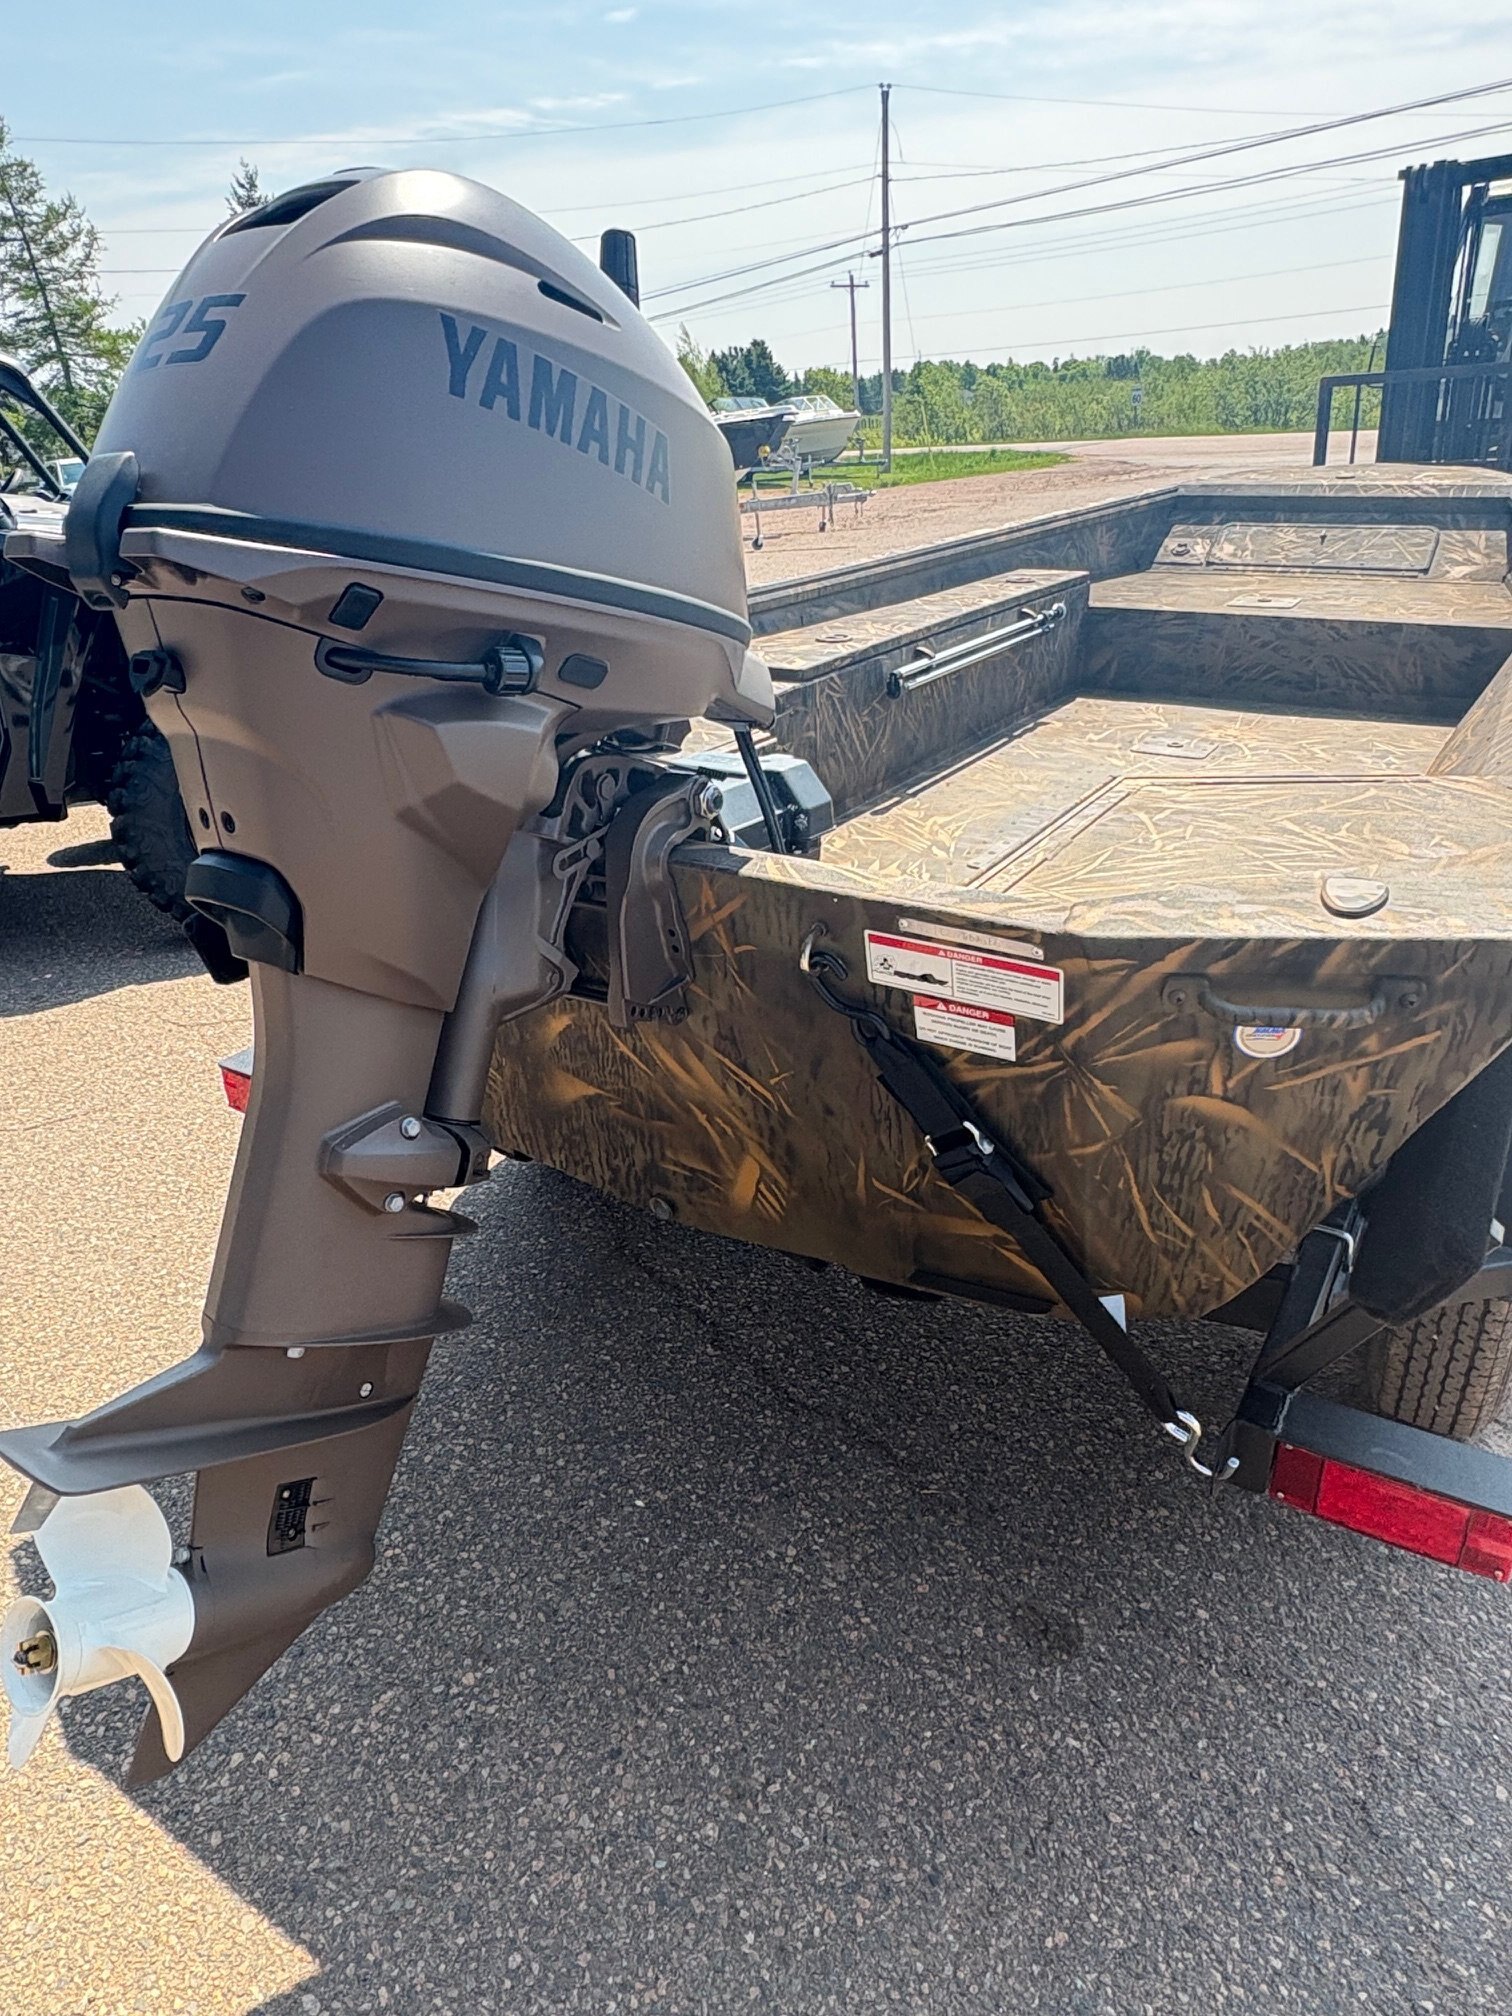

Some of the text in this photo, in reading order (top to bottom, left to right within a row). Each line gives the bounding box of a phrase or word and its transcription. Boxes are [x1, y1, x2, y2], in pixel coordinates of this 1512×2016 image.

[135, 293, 248, 371] 25
[439, 312, 670, 505] YAMAHA
[946, 951, 983, 964] DANGER
[948, 1004, 990, 1019] DANGER
